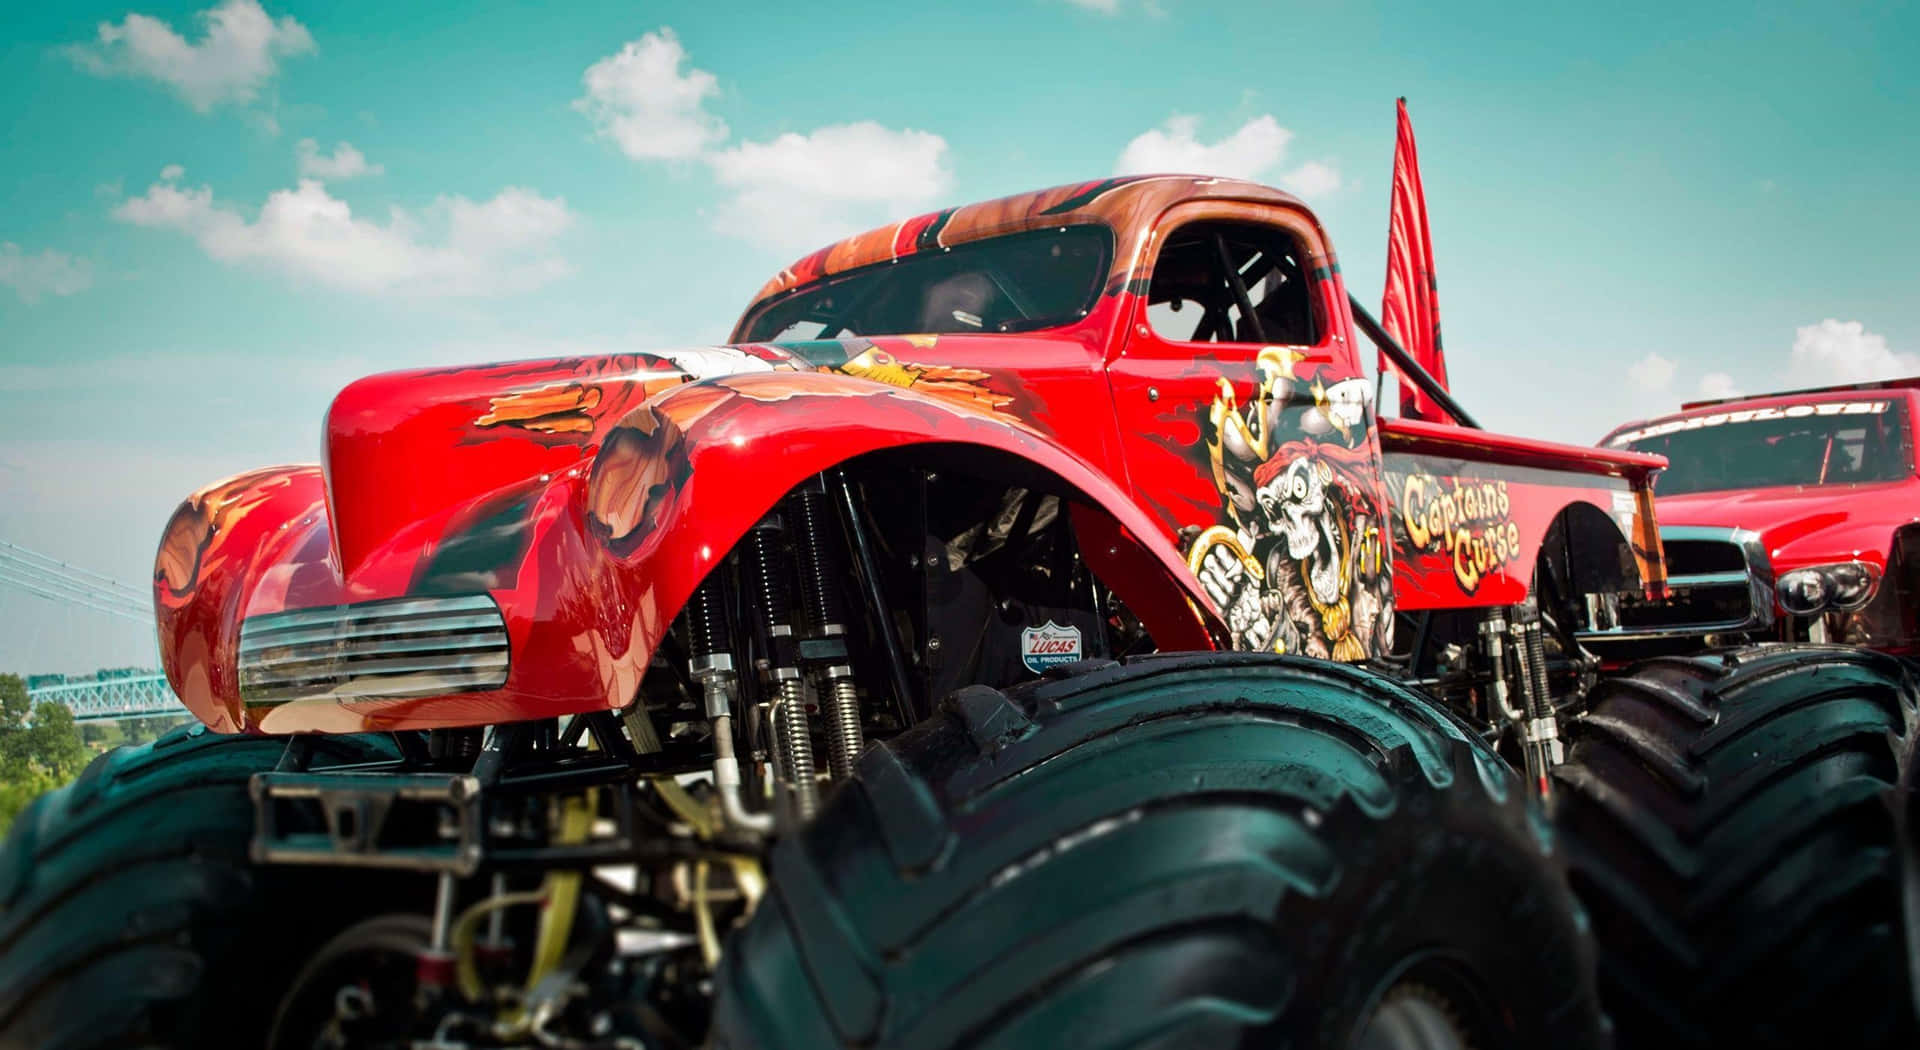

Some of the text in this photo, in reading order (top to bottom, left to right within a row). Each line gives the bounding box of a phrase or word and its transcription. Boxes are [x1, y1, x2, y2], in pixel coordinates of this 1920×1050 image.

[1402, 474, 1510, 552] Captains
[1453, 521, 1520, 593] Curse
[1030, 640, 1076, 653] LUCAS
